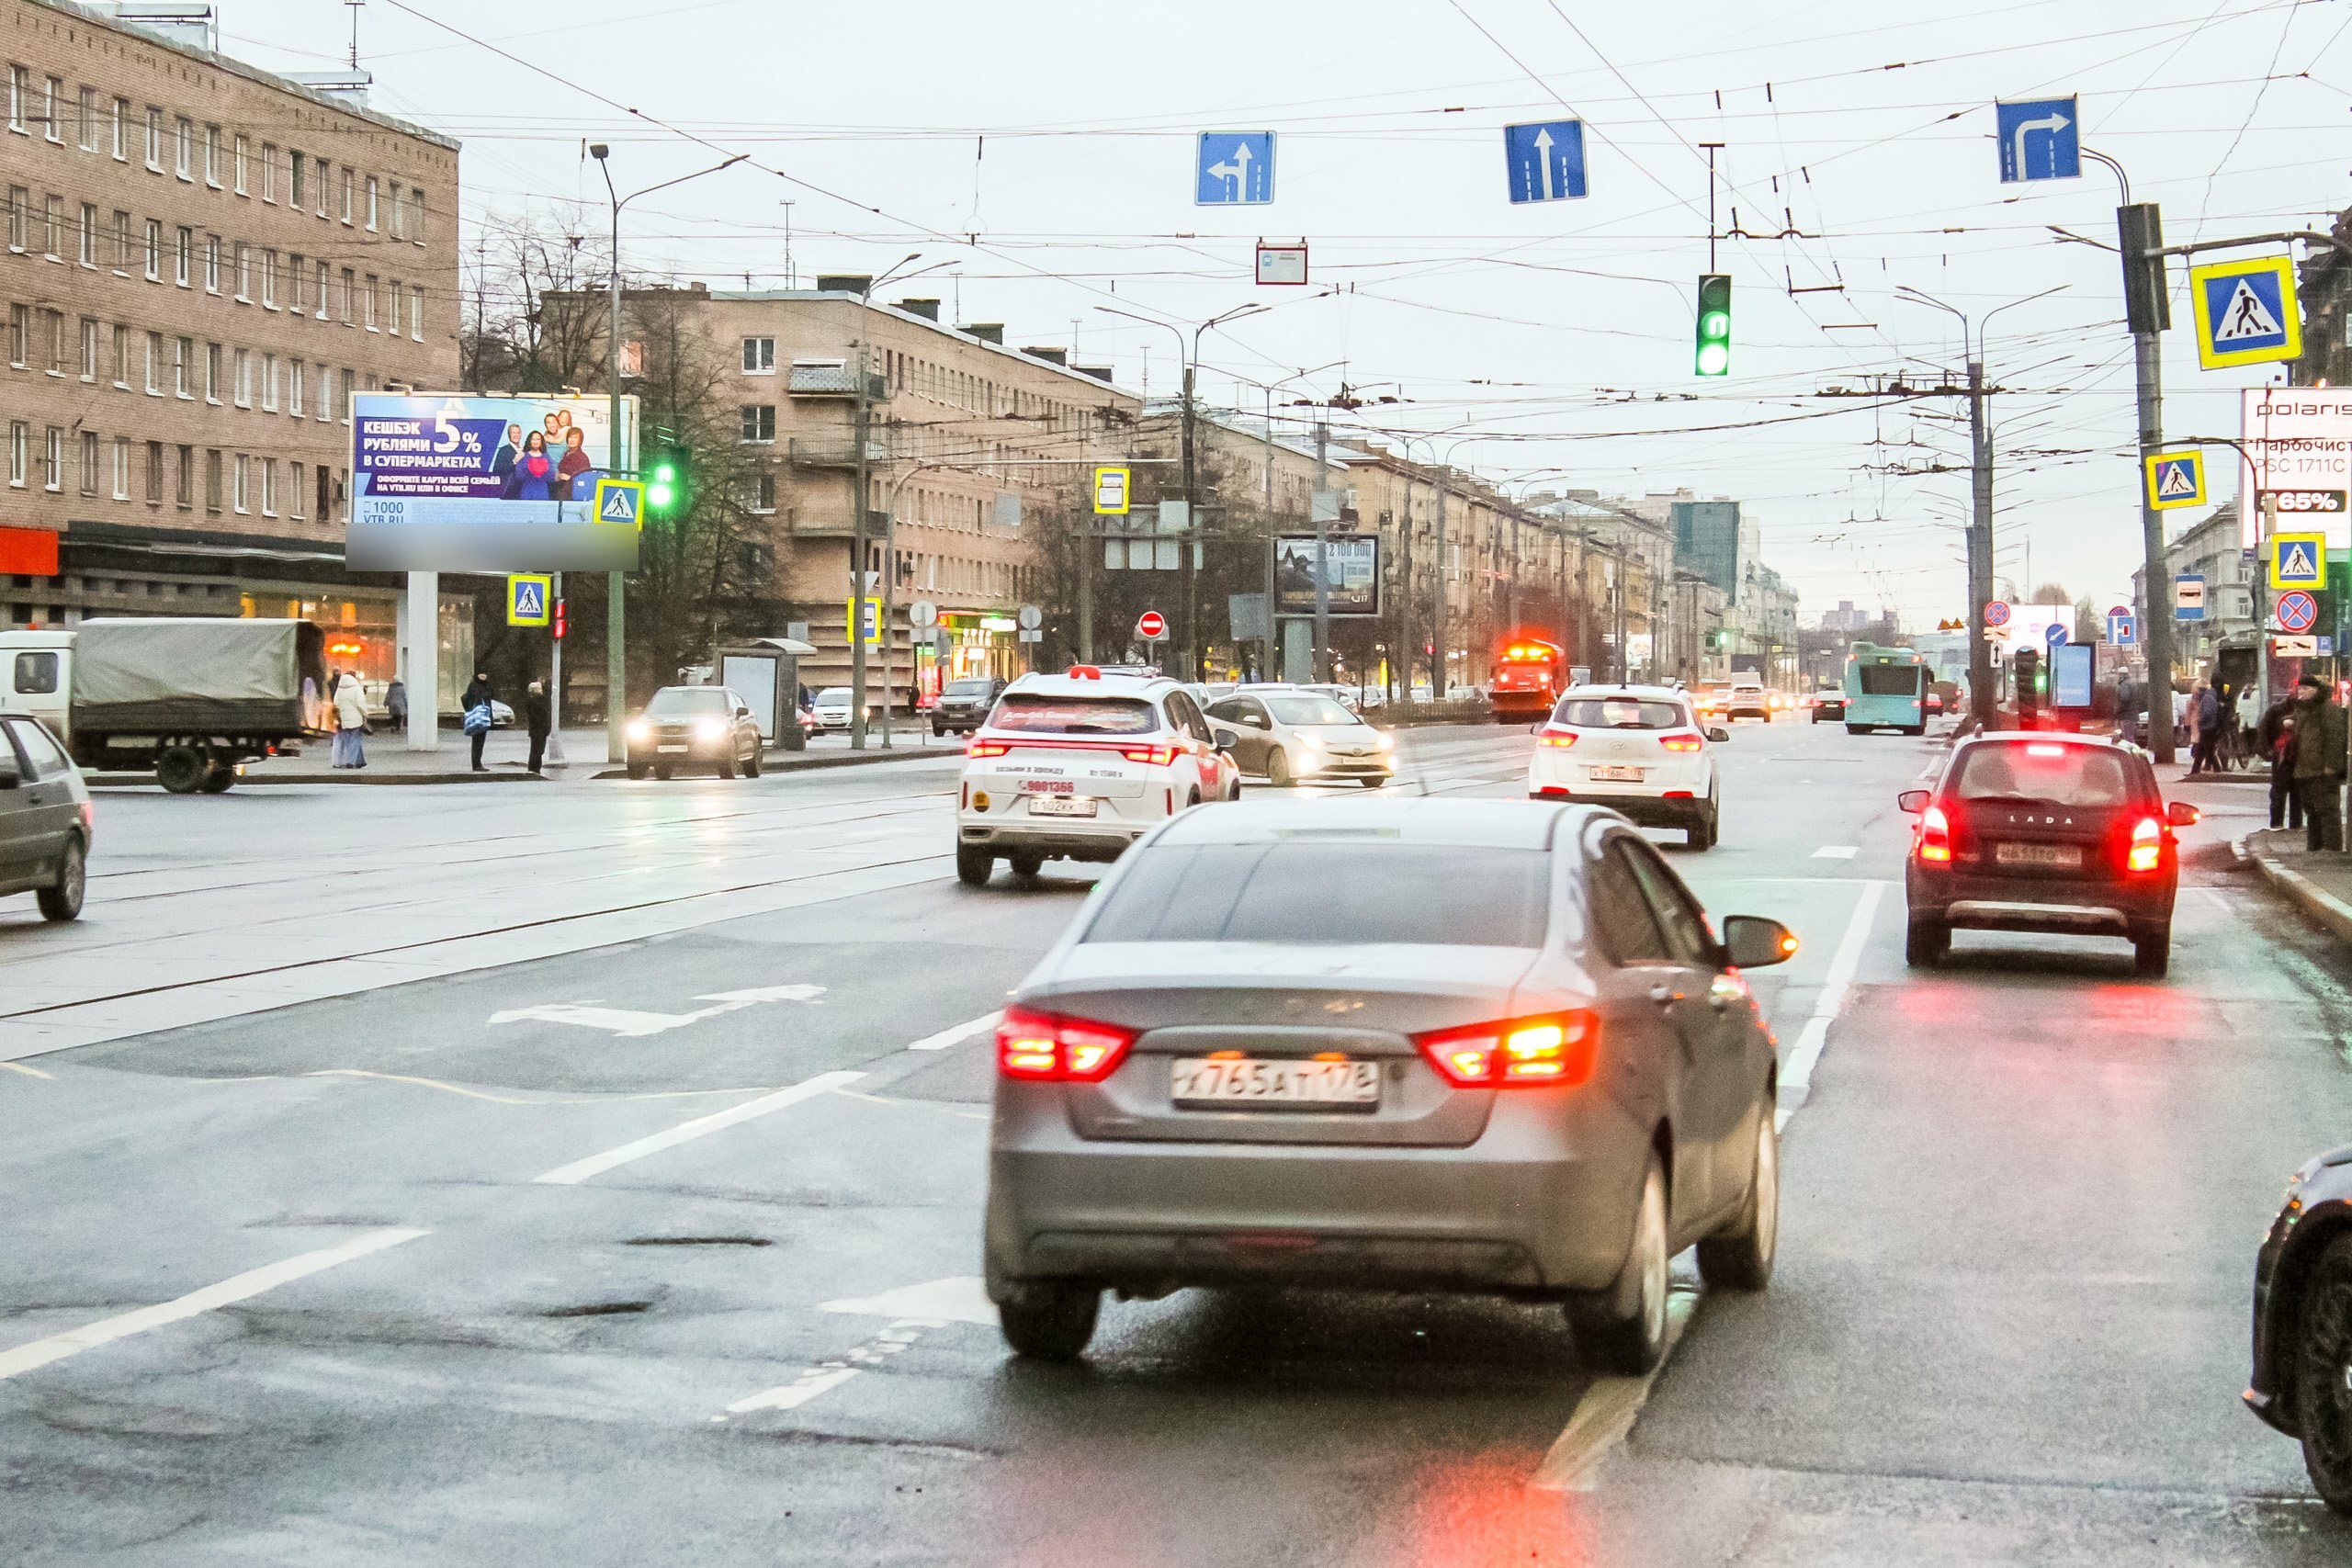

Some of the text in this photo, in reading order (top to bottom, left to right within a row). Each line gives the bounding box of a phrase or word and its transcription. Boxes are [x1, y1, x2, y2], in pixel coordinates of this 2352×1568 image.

[2256, 402, 2352, 417] polaris
[363, 421, 421, 434] КЕШБЭК
[363, 437, 431, 451] РУБЛЯМИ
[363, 455, 481, 468] В СУПЕРМАРКЕТАХ
[2256, 458, 2346, 472] PSC 1711C
[422, 476, 448, 484] КАРТЫ
[449, 476, 469, 484] ВСЕЙ
[441, 485, 469, 493] ОФИСЕ
[373, 502, 404, 513] 1000
[2278, 491, 2338, 511] 65%
[2009, 815, 2073, 824] LADA
